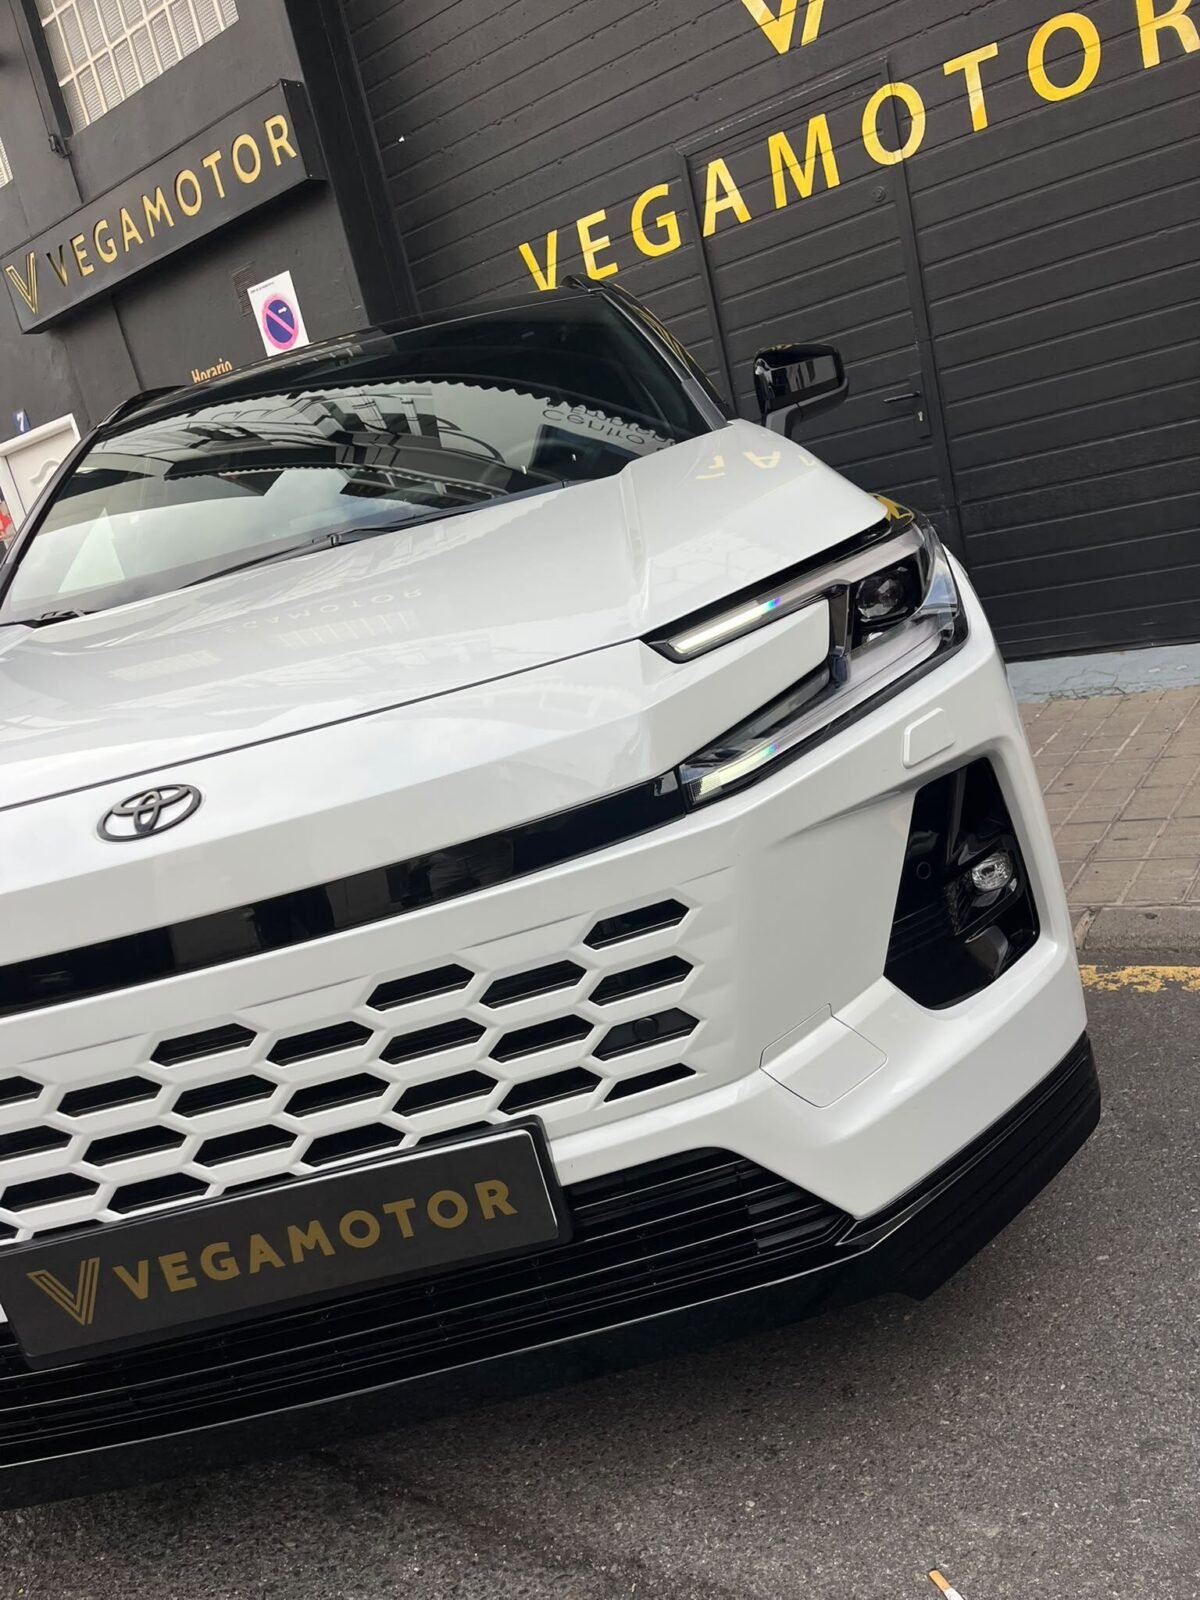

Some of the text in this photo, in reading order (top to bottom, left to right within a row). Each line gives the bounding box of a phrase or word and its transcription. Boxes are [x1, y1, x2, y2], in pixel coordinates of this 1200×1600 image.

[47, 114, 298, 287] VEGAMOTOR
[518, 0, 1200, 291] VEGAMOTOR
[113, 1180, 519, 1299] VEGAMOTOR
